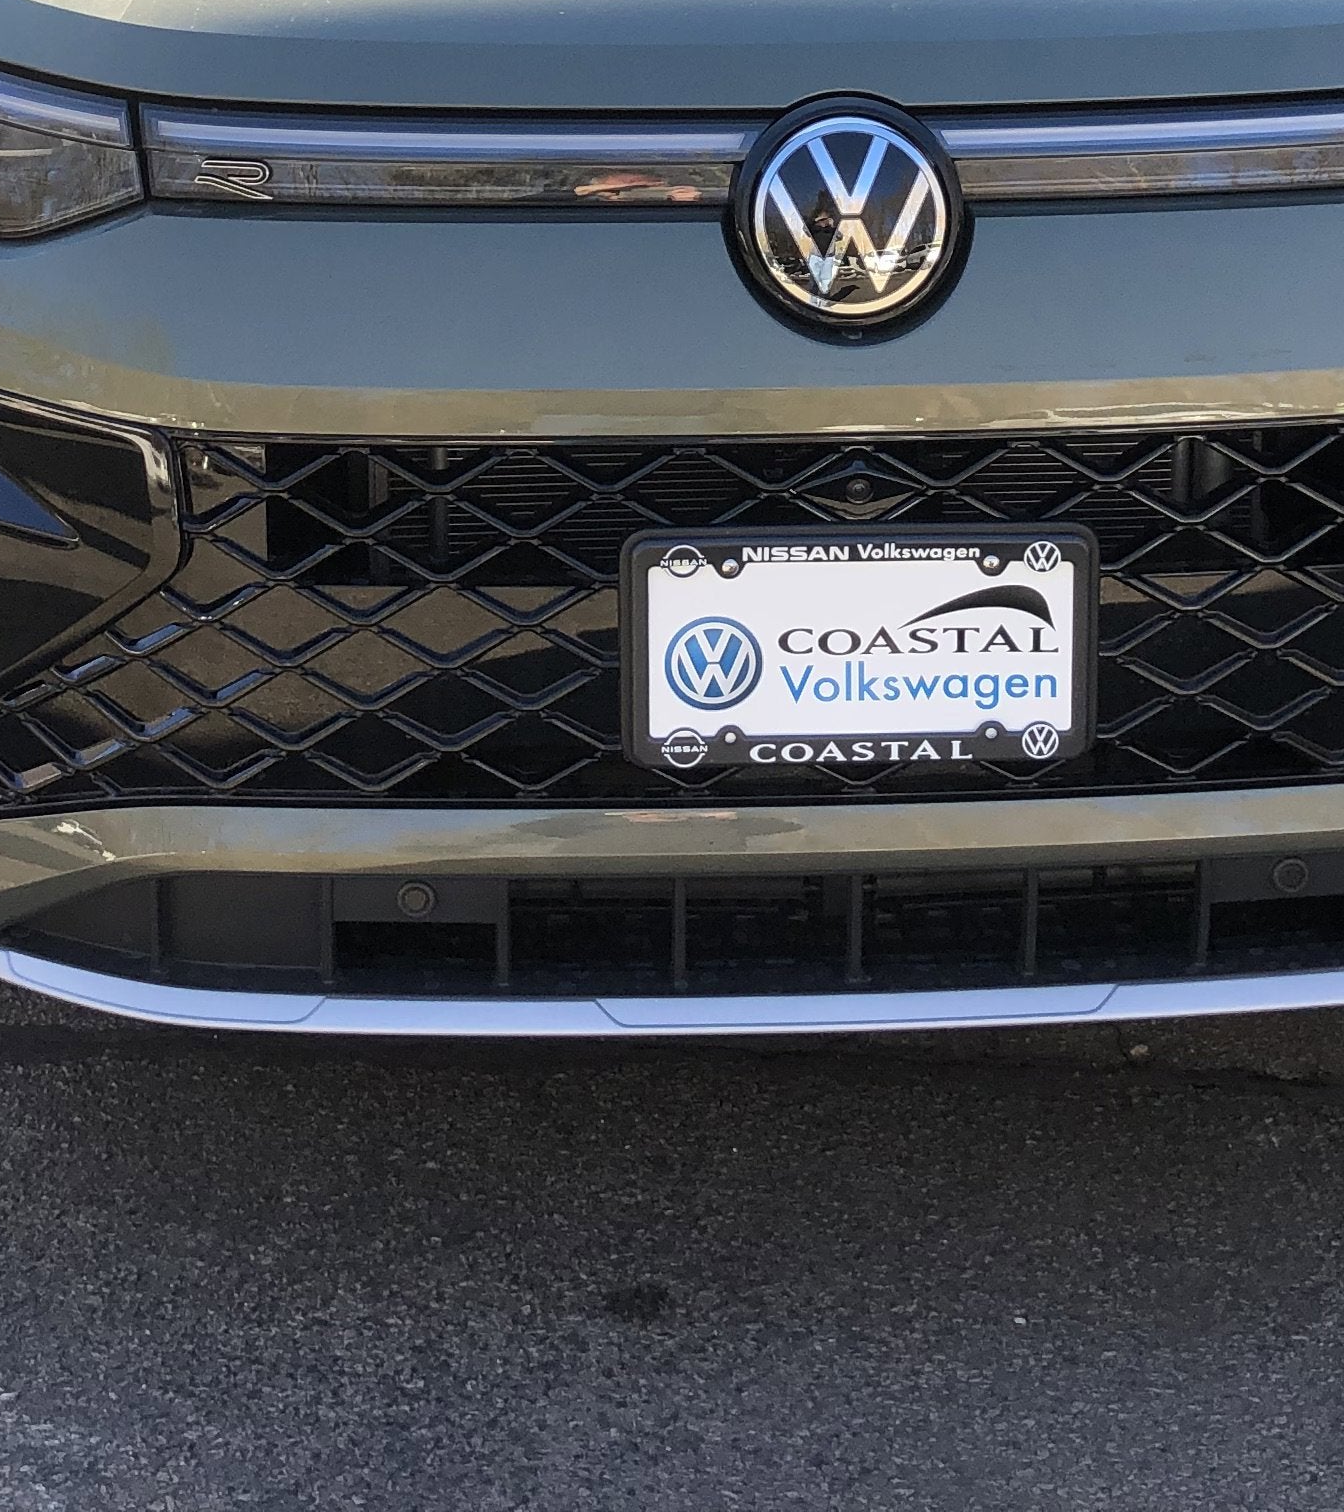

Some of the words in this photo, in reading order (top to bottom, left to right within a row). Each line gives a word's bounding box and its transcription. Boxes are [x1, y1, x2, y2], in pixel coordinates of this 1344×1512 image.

[659, 557, 707, 567] NISSAN
[742, 546, 850, 562] NISSAN
[856, 543, 981, 562] Volkswagen
[778, 624, 1059, 655] COASTAL
[780, 661, 1058, 710] Volkswagen
[660, 744, 708, 754] NISSAN
[749, 739, 973, 763] COASTAL
